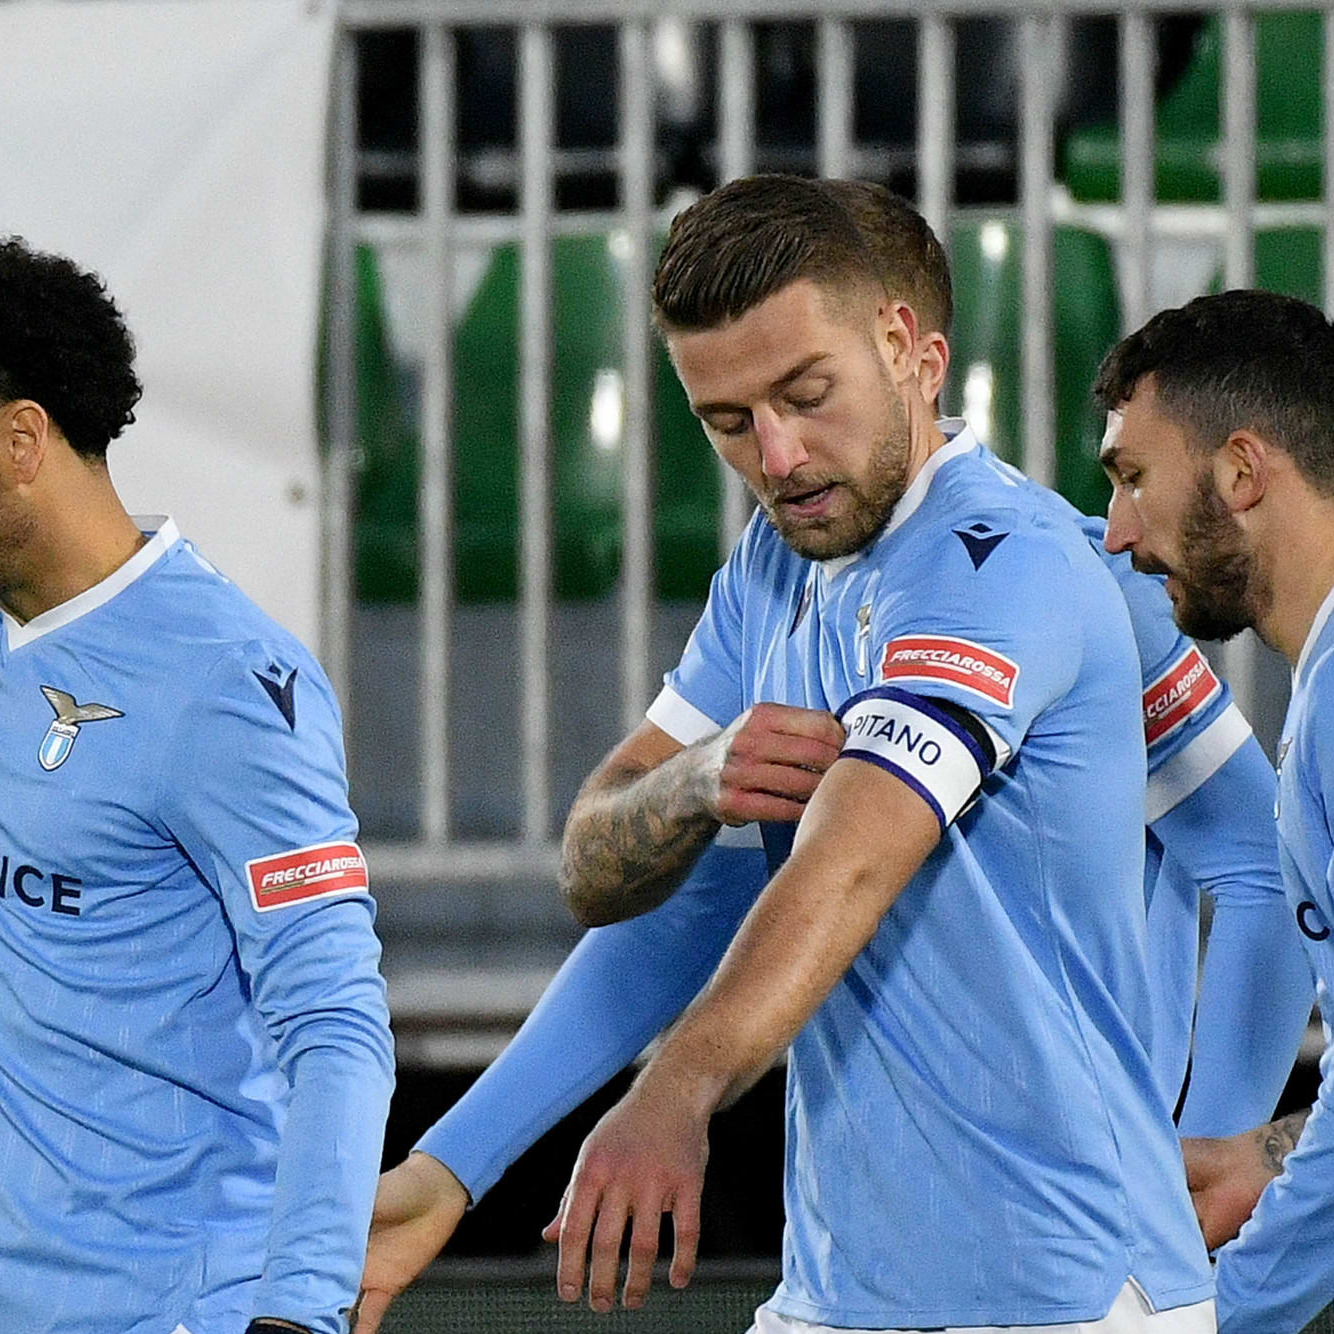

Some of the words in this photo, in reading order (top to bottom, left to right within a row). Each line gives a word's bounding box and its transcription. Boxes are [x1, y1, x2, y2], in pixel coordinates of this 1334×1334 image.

[888, 648, 1012, 690] FRECCIAROSSA
[1145, 659, 1209, 719] CCIAROSSA
[851, 713, 943, 766] PITANO
